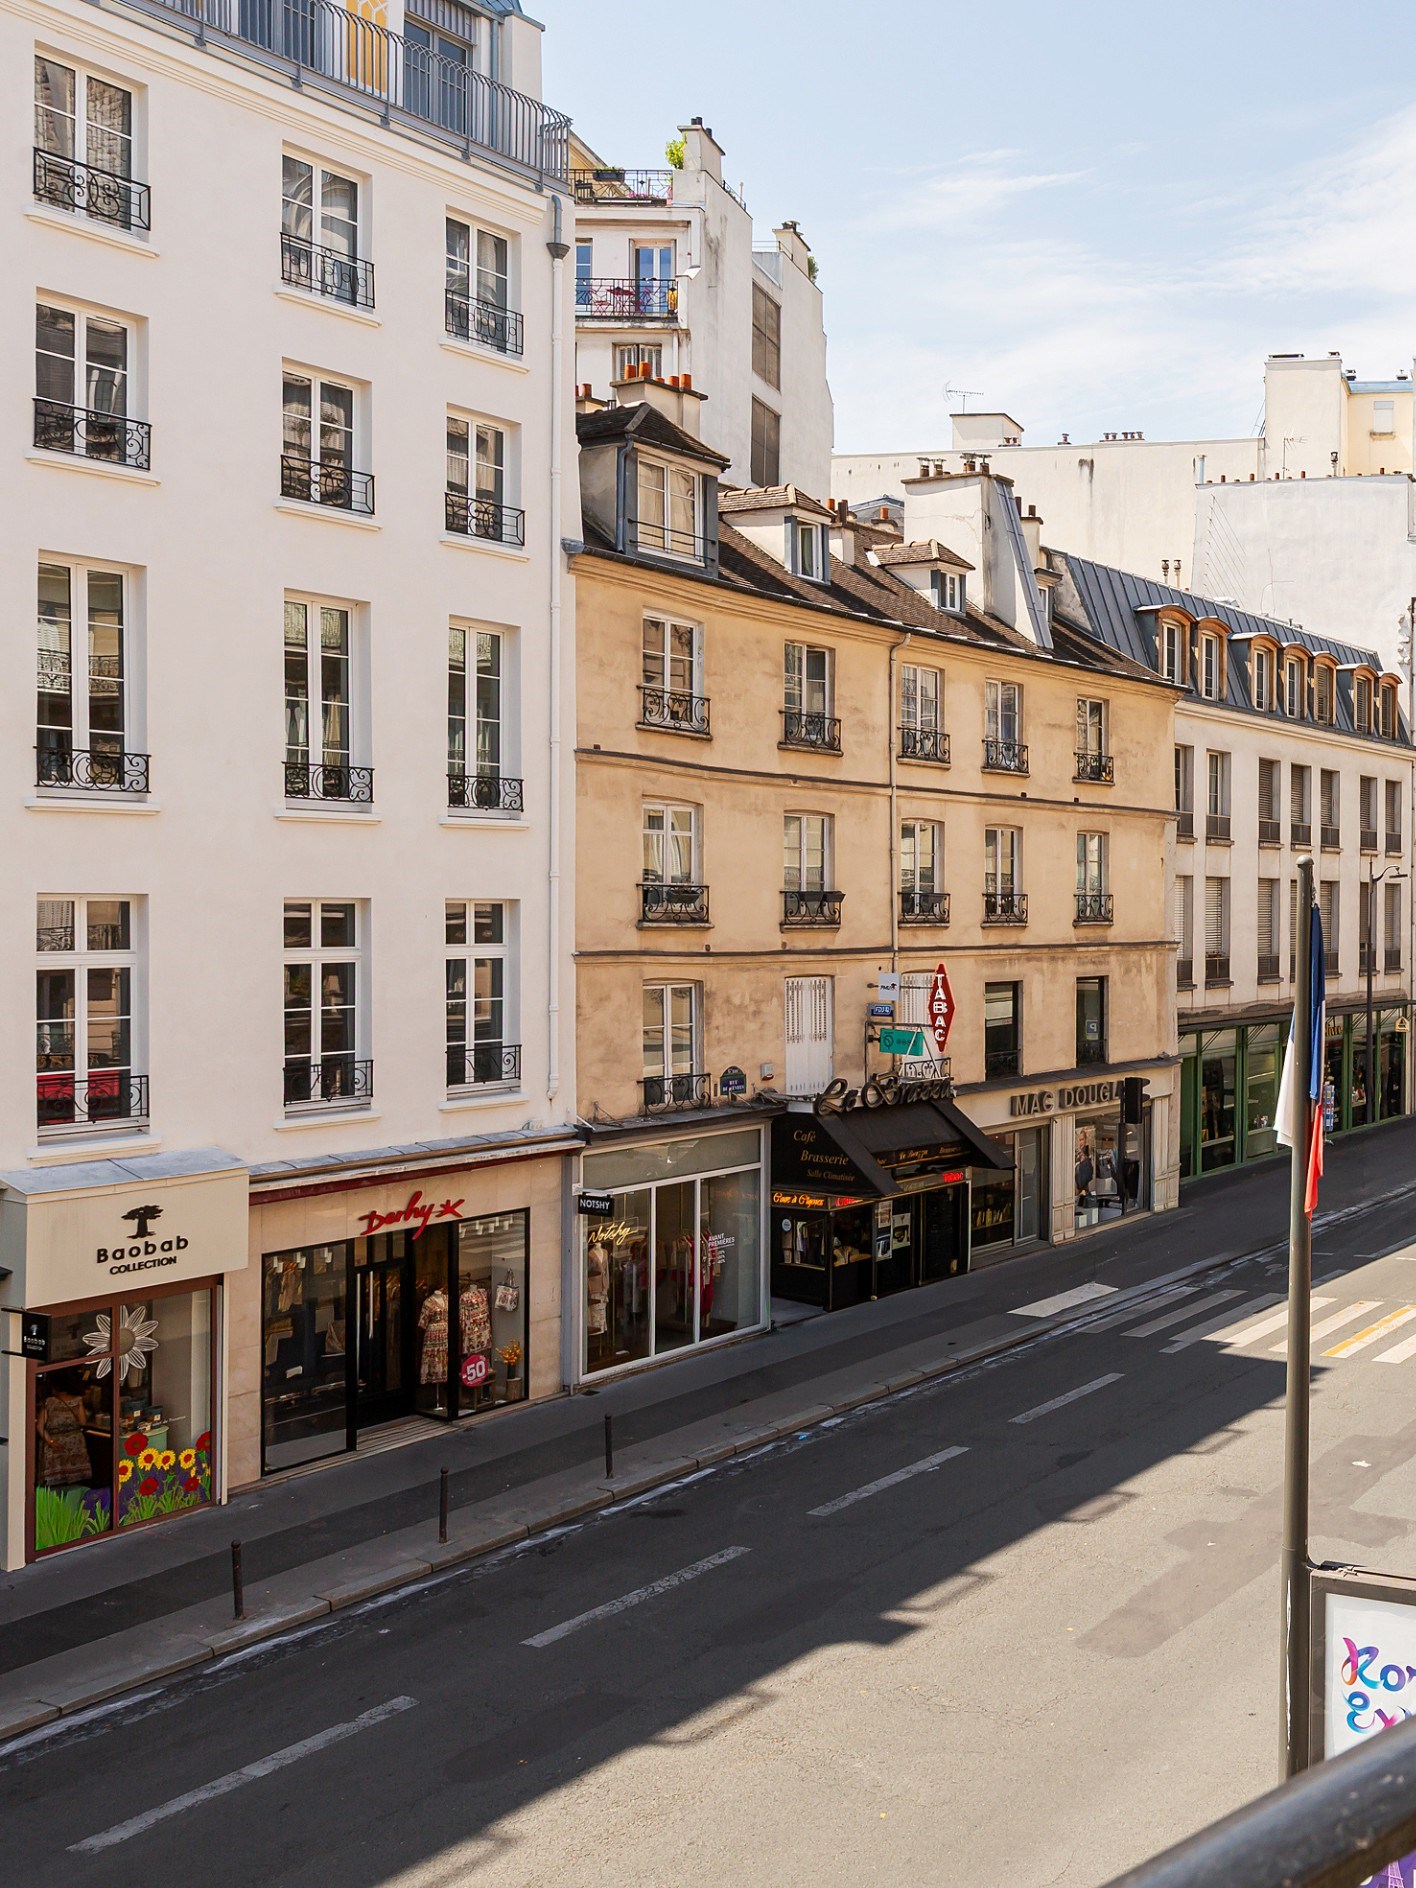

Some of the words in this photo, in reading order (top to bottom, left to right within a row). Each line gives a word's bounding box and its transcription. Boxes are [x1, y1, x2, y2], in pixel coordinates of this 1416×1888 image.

[933, 973, 948, 1041] TABAC
[815, 1078, 858, 1116] Le
[1011, 1091, 1054, 1116] MAC
[1059, 1080, 1125, 1109] DOUGL
[793, 1129, 816, 1144] Café
[801, 1149, 849, 1166] Brasserie
[358, 1190, 435, 1240] Derhy
[580, 1199, 610, 1210] NOTSHY
[96, 1235, 189, 1264] Baobab
[109, 1256, 177, 1275] COLLECTION
[1341, 1690, 1413, 1734] Ex
